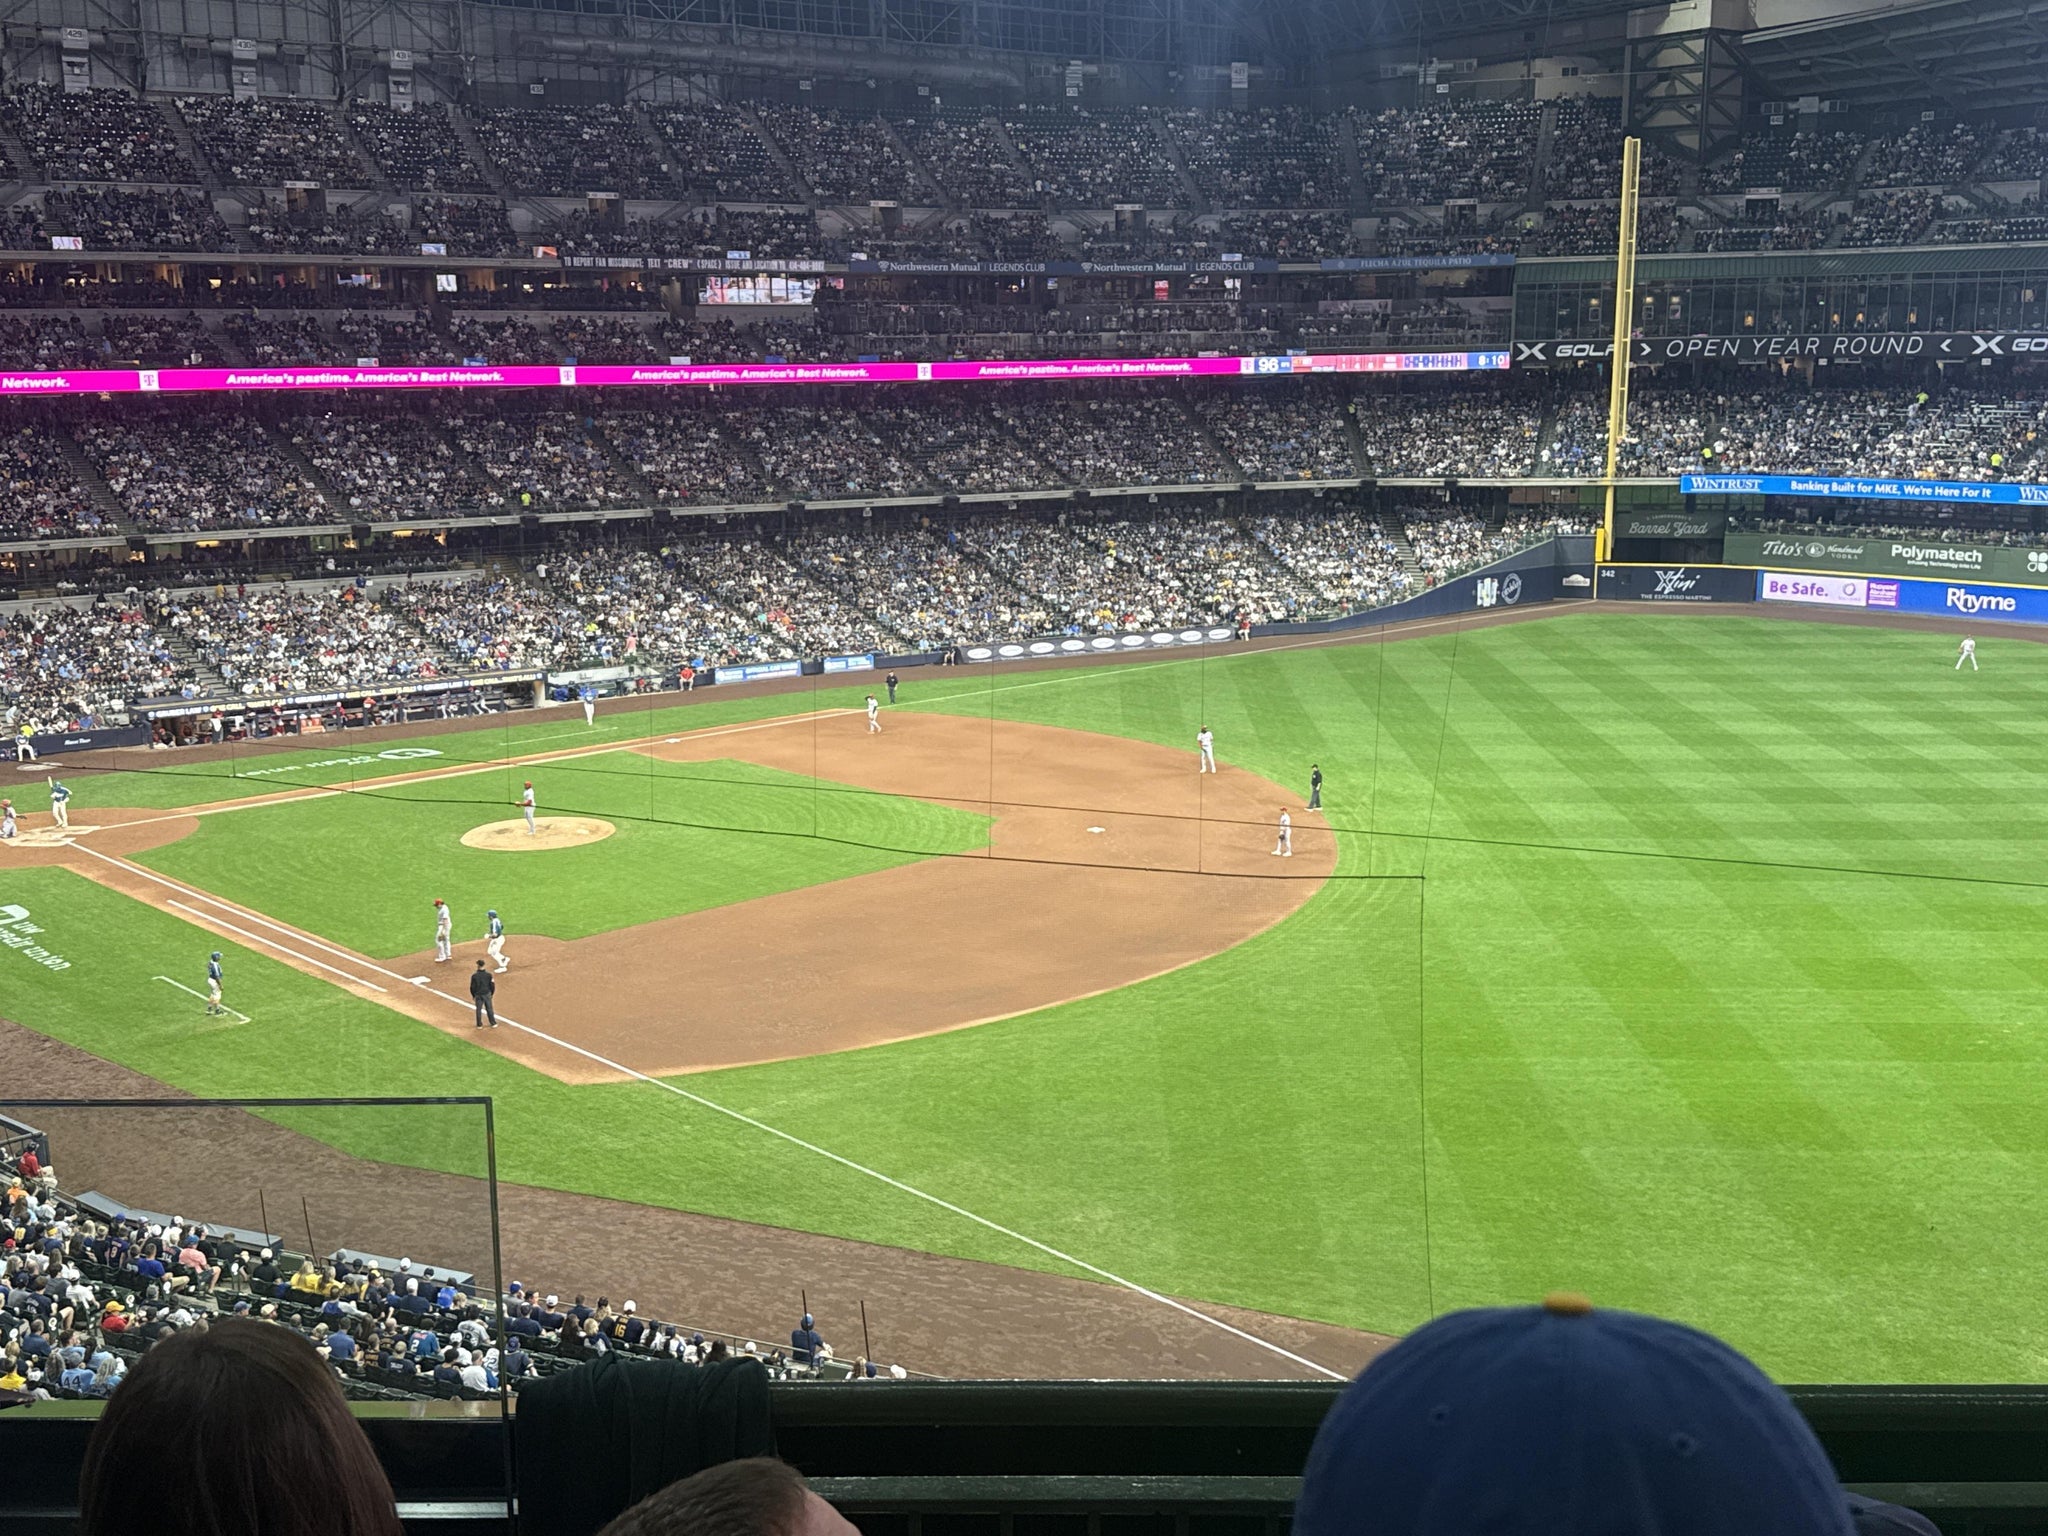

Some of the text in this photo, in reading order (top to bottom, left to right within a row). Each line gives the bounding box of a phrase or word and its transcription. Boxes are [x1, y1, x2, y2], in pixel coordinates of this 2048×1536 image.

[573, 257, 594, 267] REPORT
[595, 258, 606, 267] FAN
[647, 258, 661, 268] TEXT
[890, 262, 1045, 272] Northwestern Mutual LEGENDS CLUB
[1093, 262, 1254, 272] Northwestern Mutual LEGENDS CLUB
[1361, 257, 1471, 267] FLECHA AZUL TEQUILA PATIO
[1666, 336, 1924, 357] OPEN YEAR ROUND
[1259, 357, 1279, 371] 96
[1478, 355, 1504, 366] 8:10
[632, 367, 869, 380] America's pastime. America's Best Network.
[979, 362, 1192, 375] America's pastime. America's Best Network.
[2, 377, 70, 388] Network.
[226, 371, 504, 385] America's pastime. America's Best Network.
[1691, 477, 1760, 489] WINTRUST
[1791, 480, 1991, 498] Banking Built for MKE, We're Here For It
[1629, 522, 1708, 537] Barrel Yard
[1763, 540, 1803, 556] Tito's
[1891, 544, 1982, 563] Polymatech
[1601, 570, 1615, 578] 342
[1655, 568, 1701, 594] Xtini
[1770, 581, 1828, 597] Be Safe.
[1946, 587, 2015, 613] Rhyme
[22, 946, 71, 971] union
[615, 1323, 626, 1337] 16
[411, 1339, 419, 1352] 2
[64, 1374, 81, 1387] 44
